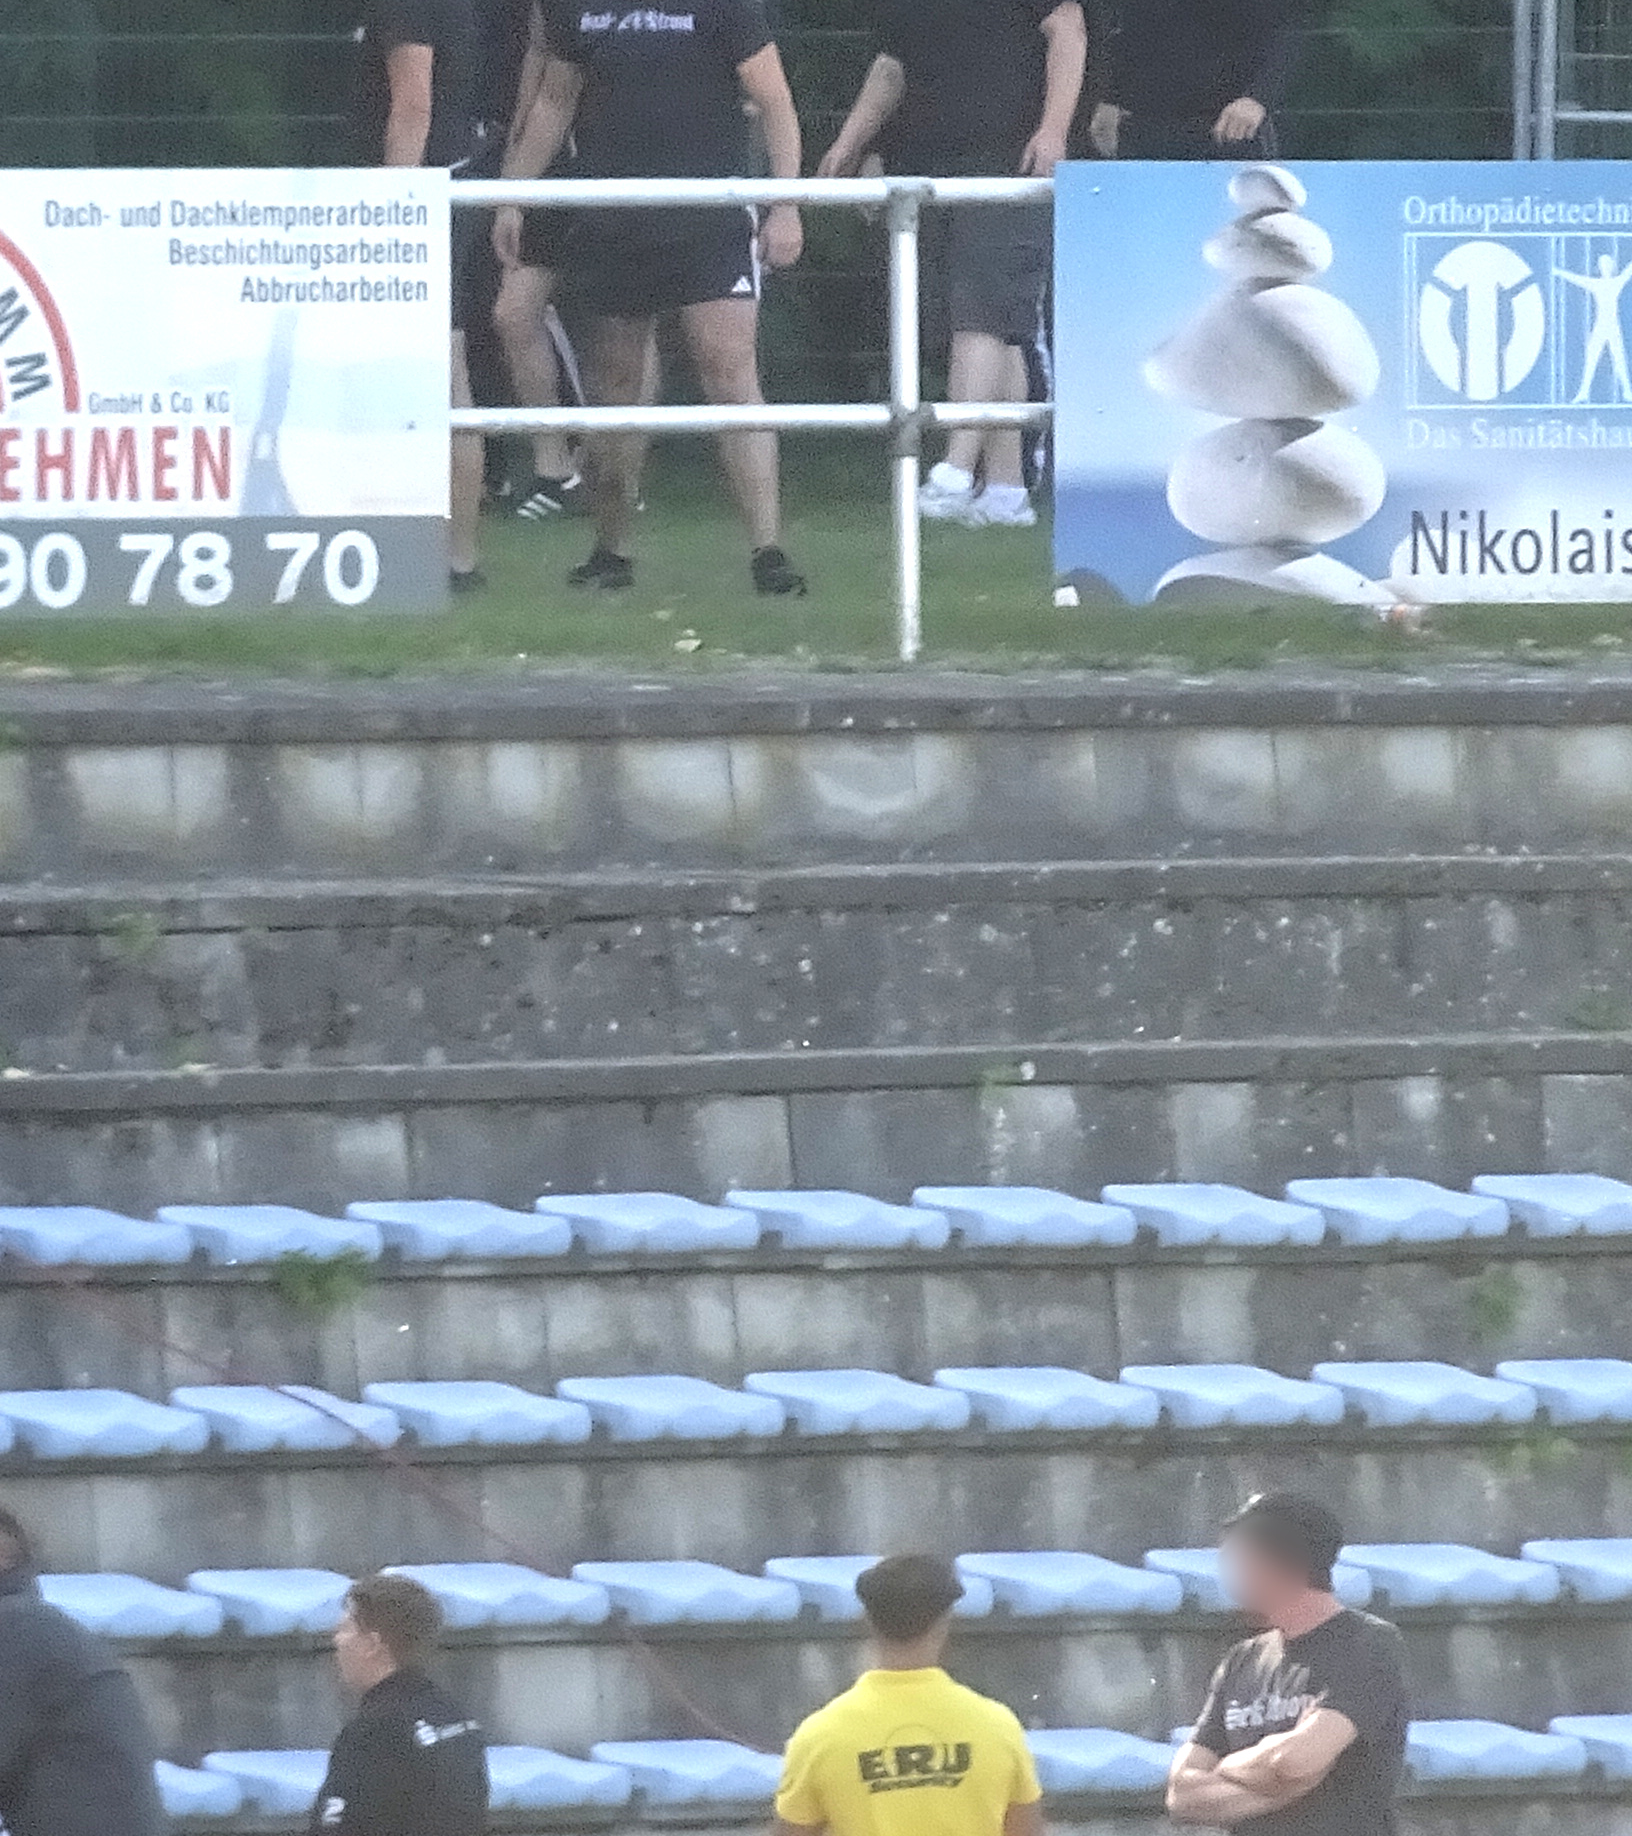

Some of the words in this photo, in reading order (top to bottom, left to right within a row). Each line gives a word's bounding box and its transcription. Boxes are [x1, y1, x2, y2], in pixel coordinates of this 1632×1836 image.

[44, 200, 111, 228] Dach-
[120, 201, 162, 228] und
[171, 199, 429, 232] Dachklempnerarbeiten
[167, 237, 429, 270] Beschichtungsarbeiten
[239, 275, 429, 304] Abbrucharbeiten
[205, 390, 230, 414] KG
[118, 530, 235, 608] 78
[265, 528, 381, 607] 70
[858, 1741, 972, 1781] ERU
